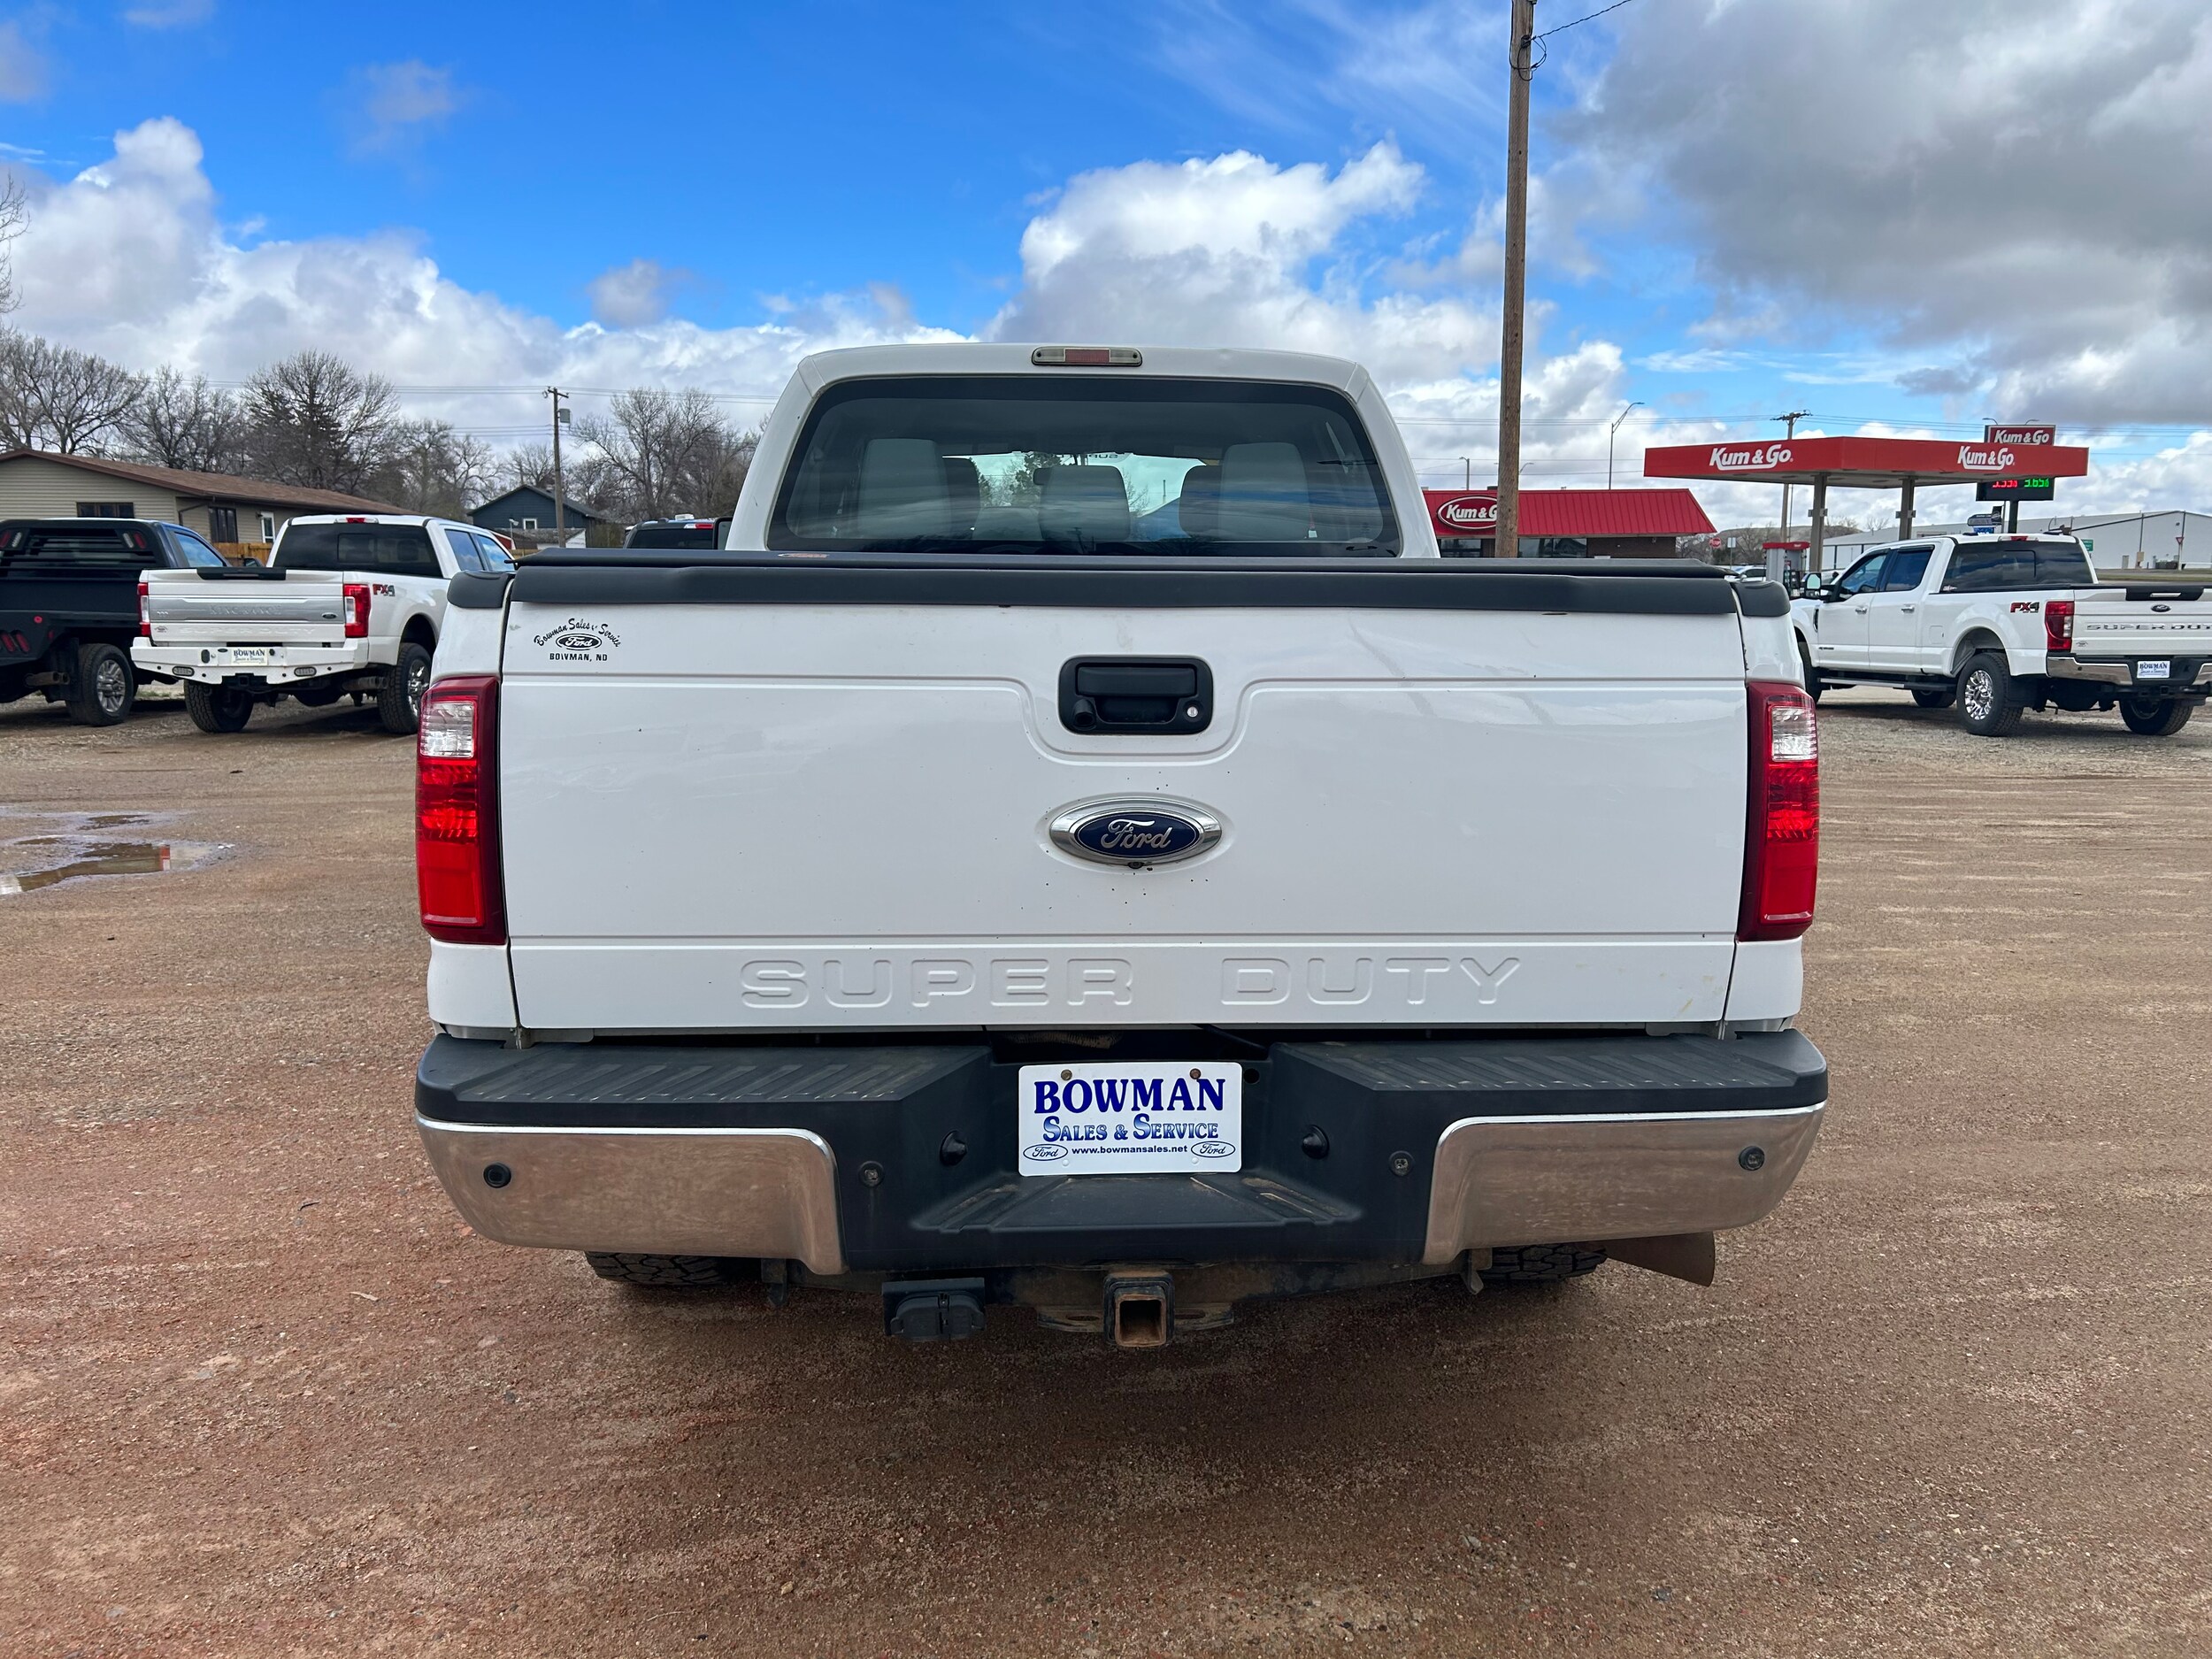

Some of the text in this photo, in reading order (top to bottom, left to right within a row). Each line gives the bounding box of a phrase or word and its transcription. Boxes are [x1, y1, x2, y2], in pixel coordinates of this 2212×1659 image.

[1994, 430, 2050, 444] Kum & Go
[1709, 444, 1792, 467] Kum & Go
[1957, 446, 2015, 466] Kum & Go
[1446, 504, 1498, 520] Kum & G
[2010, 602, 2039, 613] FX4
[568, 618, 590, 630] Sales
[565, 636, 593, 646] Ford
[1101, 818, 1173, 849] Ford
[741, 957, 1521, 1009] SUPER DUTY
[1033, 1077, 1225, 1114] BOWMAN
[1042, 1113, 1219, 1142] SALES & SERVICE
[1031, 1147, 1060, 1158] Ford
[1071, 1144, 1188, 1155] www.bowmansales.net
[1199, 1144, 1228, 1156] Ford
